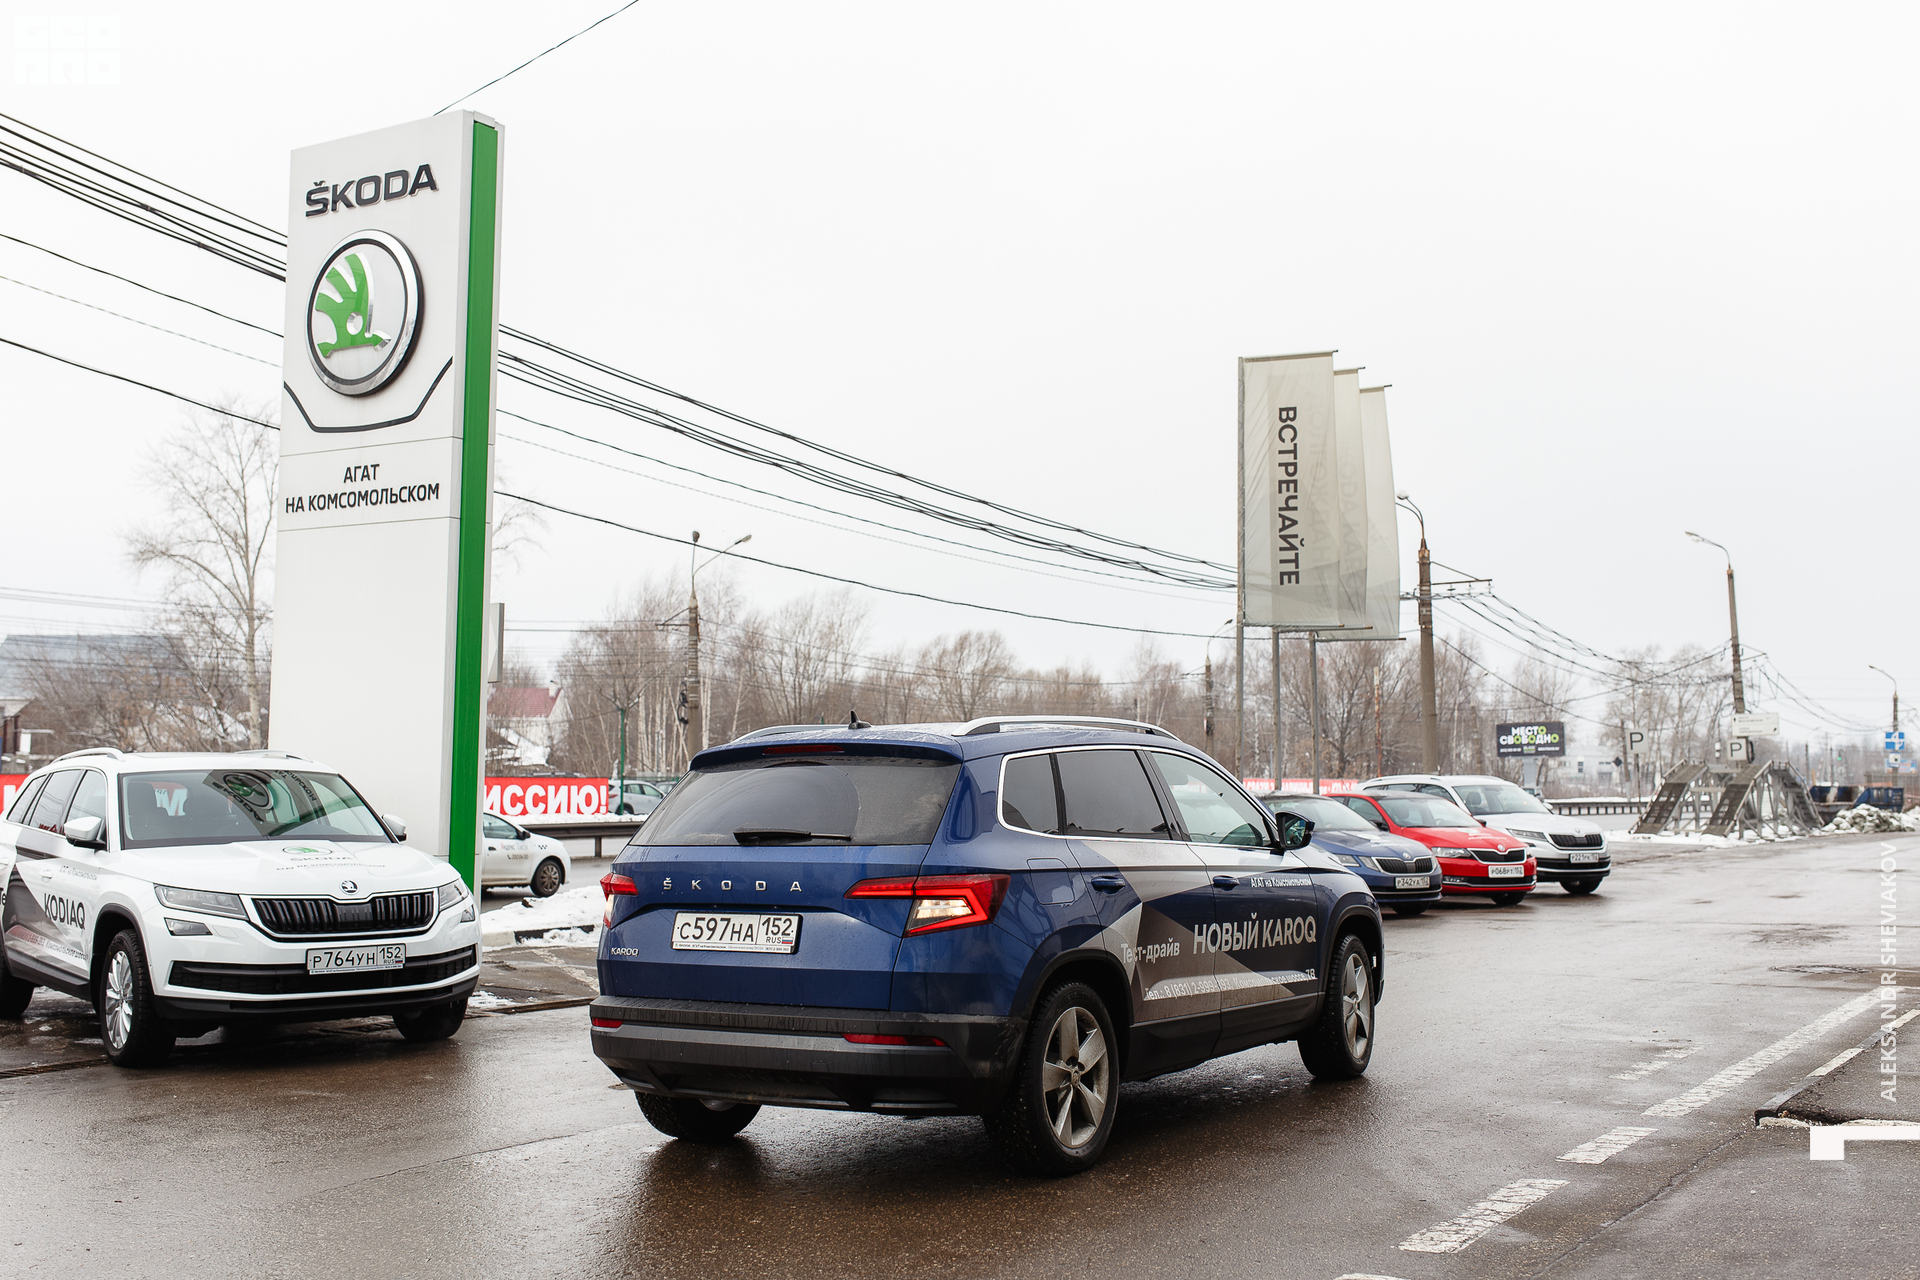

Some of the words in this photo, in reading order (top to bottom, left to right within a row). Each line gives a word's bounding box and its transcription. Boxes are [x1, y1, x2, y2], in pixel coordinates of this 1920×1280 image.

[306, 163, 438, 217] ŠKODA
[343, 464, 380, 483] АГАТ
[285, 496, 305, 513] НА
[308, 483, 440, 511] КОМСОМОЛЬСКОМ
[1278, 406, 1305, 586] ВСТРЕЧАЙТЕ
[1499, 733, 1559, 745] СВОБОДНО
[1511, 726, 1547, 736] МЕСТО
[663, 878, 802, 892] ŠKODA
[44, 893, 86, 930] KODIAQ
[762, 917, 793, 936] 152
[766, 936, 782, 944] RUS
[1121, 937, 1180, 964] Тест-драйв
[1193, 912, 1259, 954] НОВЫЙ
[1262, 916, 1316, 948] KAROQ
[379, 946, 402, 960] 152
[611, 947, 639, 958] KAROQ
[1165, 985, 1171, 997] 8
[1171, 983, 1192, 999] (831)
